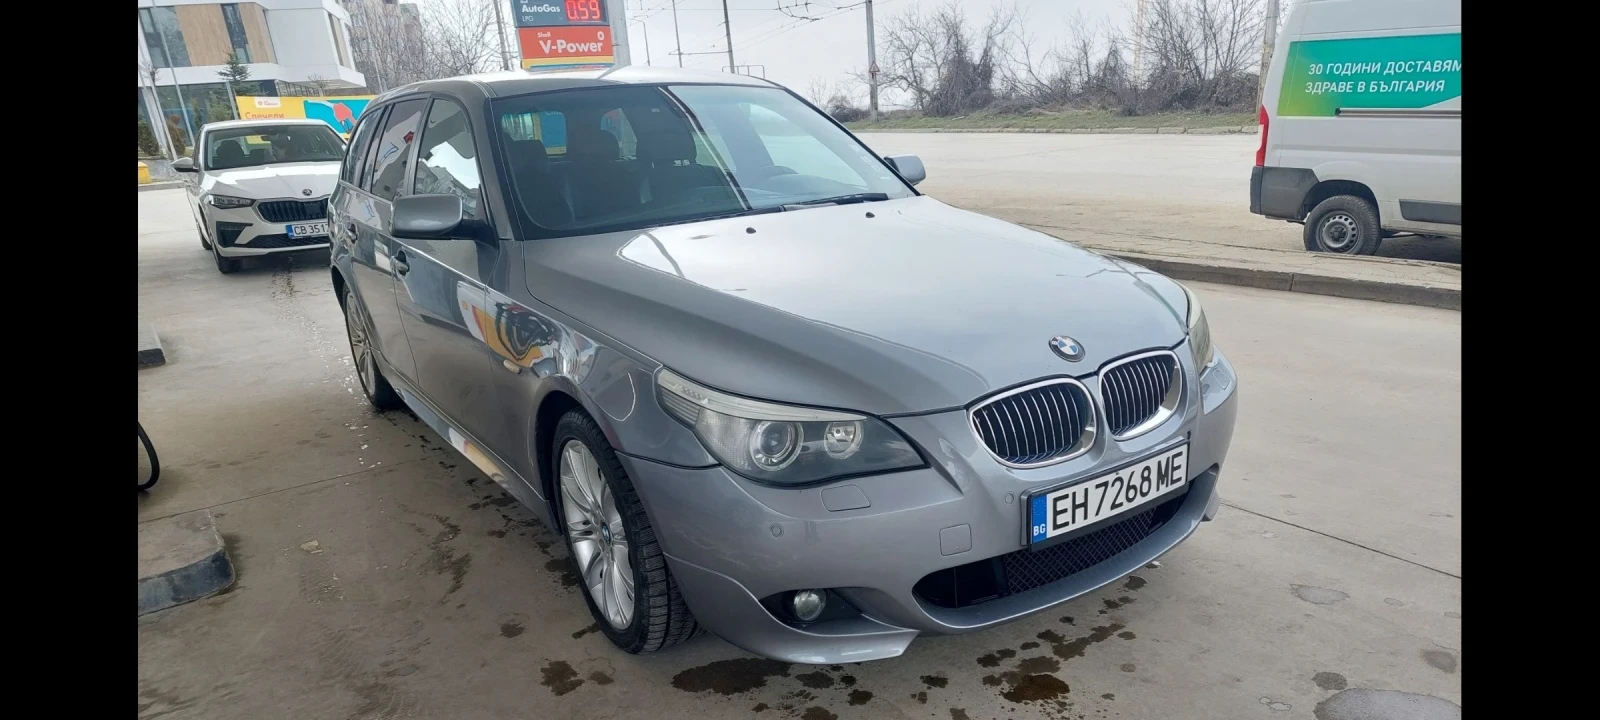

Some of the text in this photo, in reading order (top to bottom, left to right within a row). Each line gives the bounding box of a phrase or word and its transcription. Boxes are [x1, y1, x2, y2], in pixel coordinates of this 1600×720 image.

[521, 4, 561, 13] AutoGas
[539, 39, 603, 54] V-Power
[1308, 63, 1323, 75] 30
[1326, 61, 1381, 77] ГОДИНИ
[1304, 79, 1446, 95] ЗДРАВЕ В БЪЛГАРИЯ
[293, 225, 308, 236] CB
[1052, 450, 1183, 531] EH 7268 ME
[1033, 523, 1046, 537] BG
